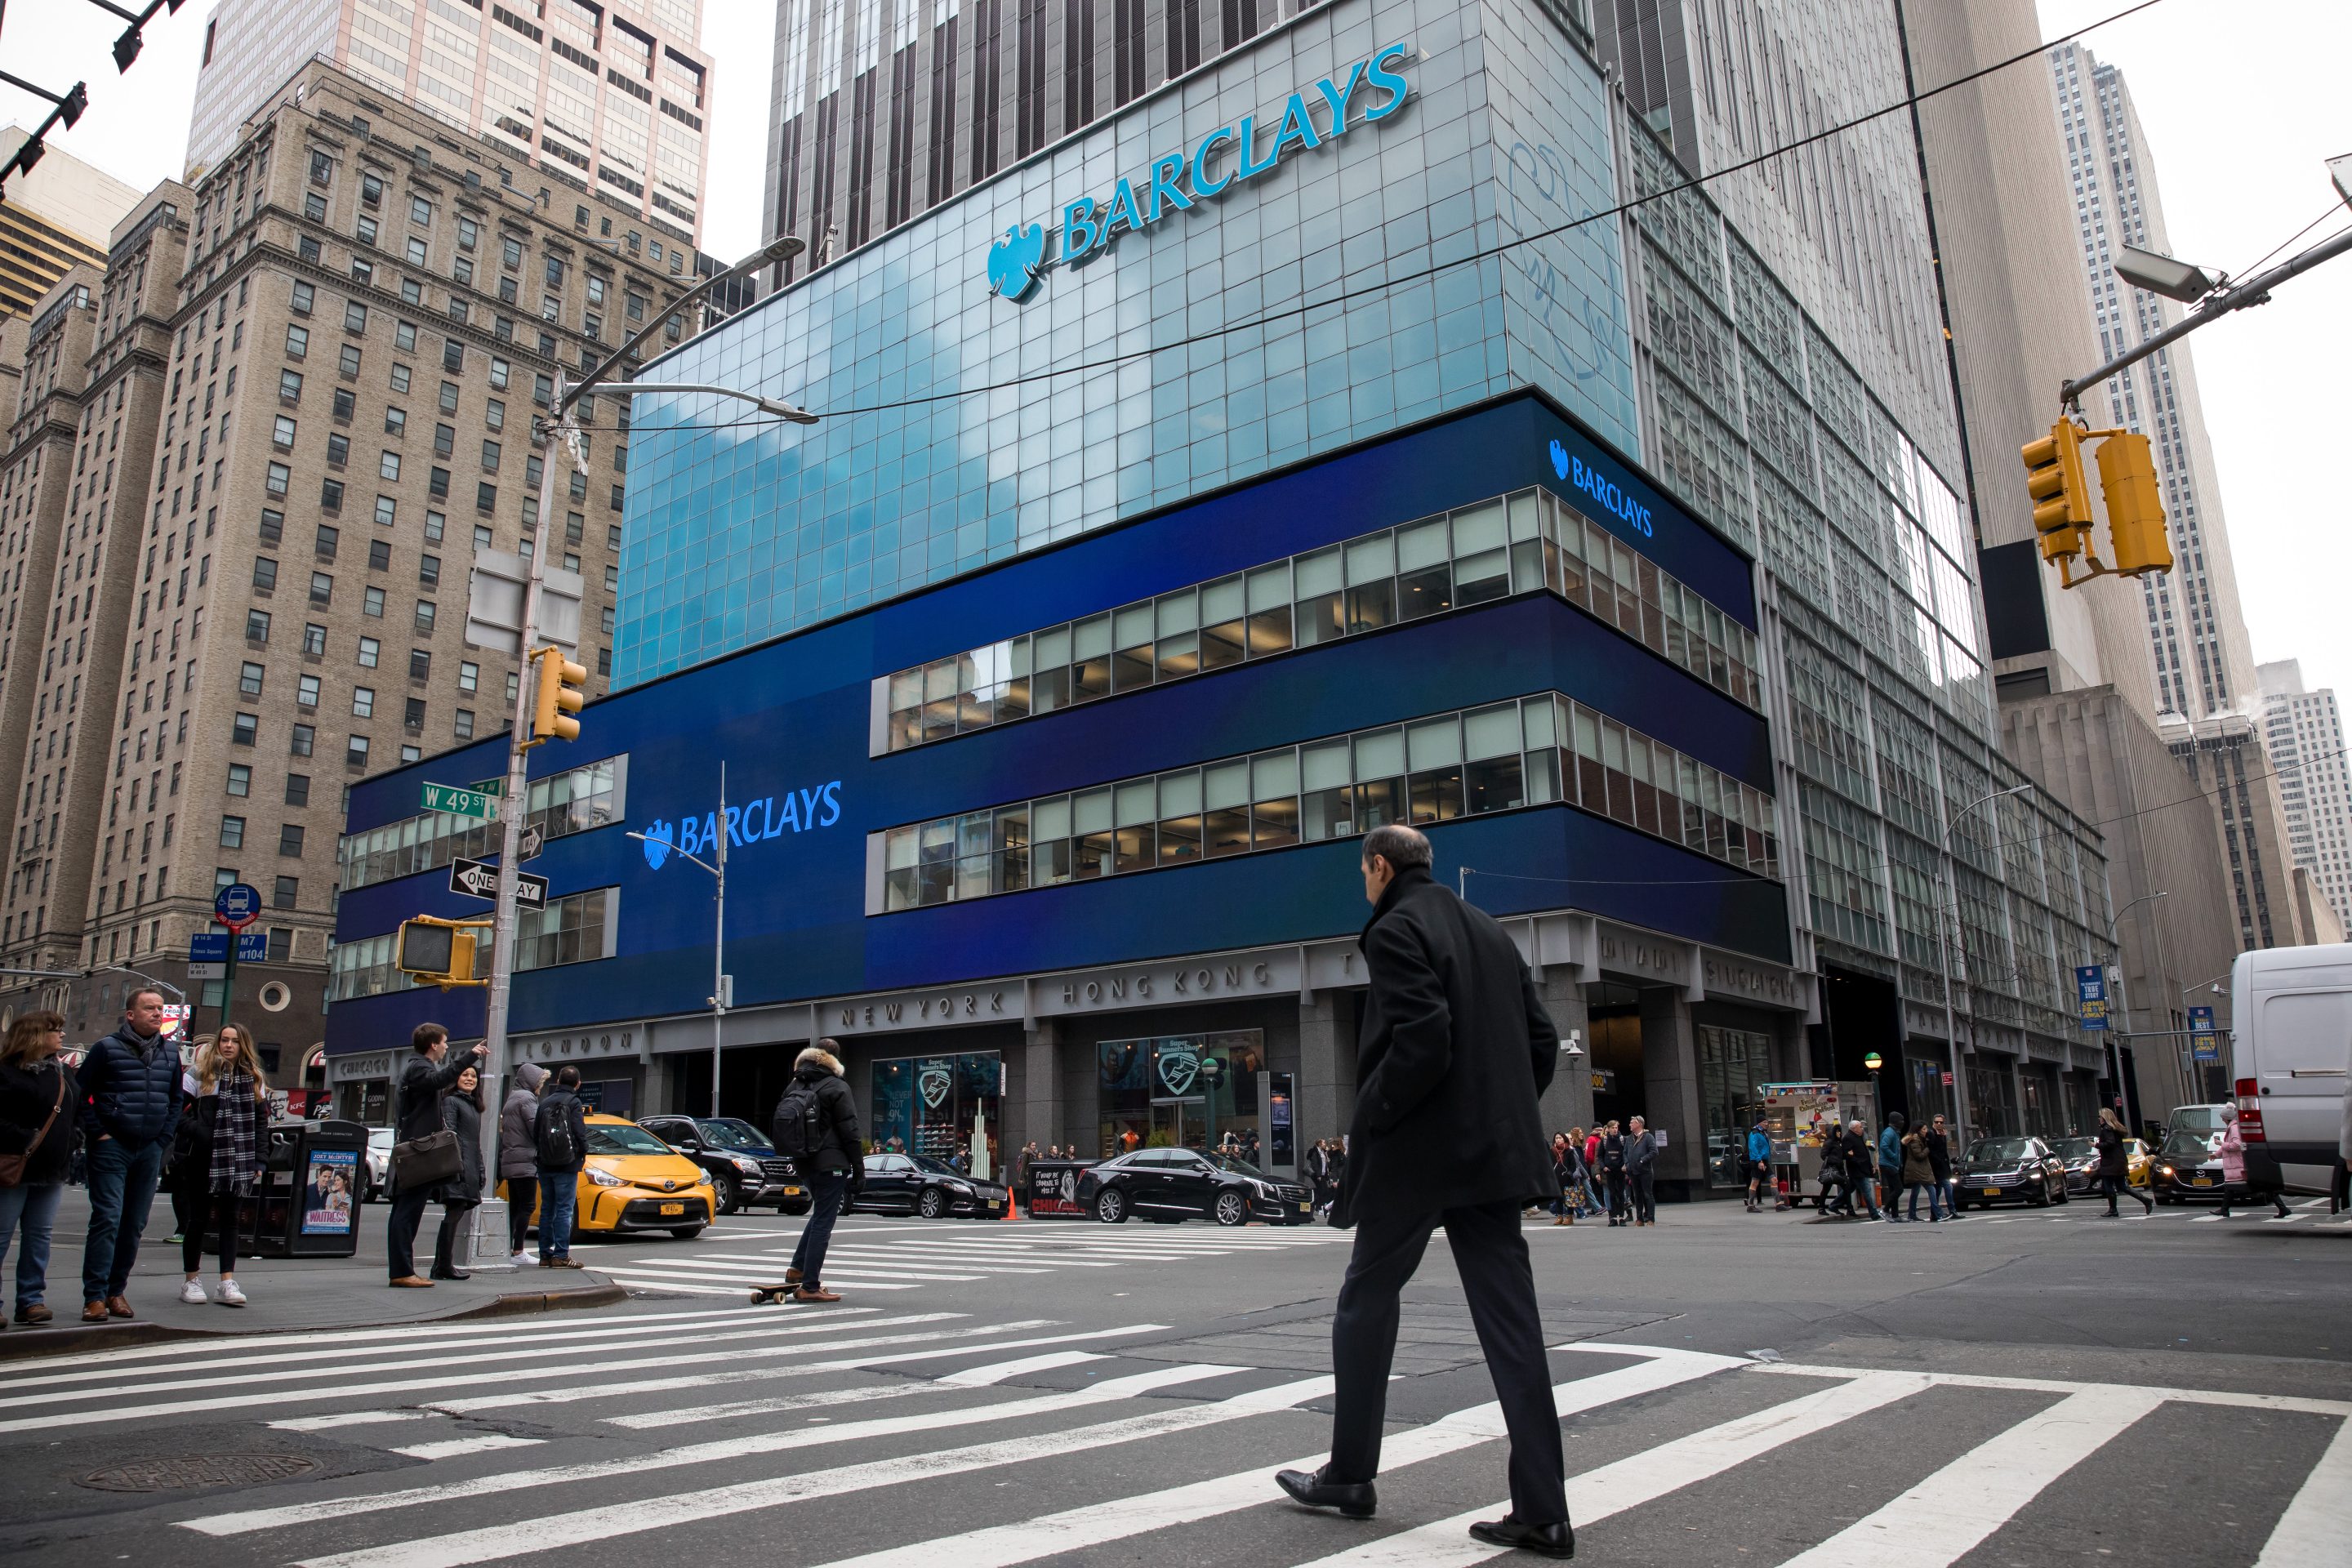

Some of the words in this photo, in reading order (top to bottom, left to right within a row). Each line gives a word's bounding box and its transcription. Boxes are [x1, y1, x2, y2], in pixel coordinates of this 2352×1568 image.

[1060, 42, 1408, 265] BARCLAYS
[1572, 456, 1653, 538] BARCLAYS
[488, 782, 497, 791] AV
[426, 786, 440, 808] W
[446, 791, 470, 812] 49
[473, 797, 486, 808] ST
[679, 781, 841, 858] BARCLAYS
[524, 834, 537, 853] WAY
[467, 871, 495, 889] ONE
[517, 883, 536, 898] AY
[219, 914, 227, 922] NO
[227, 914, 256, 926] STANDING
[240, 936, 256, 946] M7
[238, 949, 263, 960] M104
[1062, 976, 1150, 1004] HONG
[1174, 962, 1267, 991] KONG
[842, 1004, 899, 1025] NEW
[917, 992, 1001, 1018] YORK
[2083, 1011, 2105, 1019] AWAY
[526, 1032, 632, 1058] LONDON
[1169, 1040, 1187, 1048] Super
[1184, 1045, 1200, 1053] Shop
[368, 1094, 385, 1102] GODIVA
[290, 1101, 305, 1111] KFC
[889, 1100, 904, 1109] NOT
[1036, 1171, 1040, 1179] IT
[310, 1211, 346, 1223] WAITRESS
